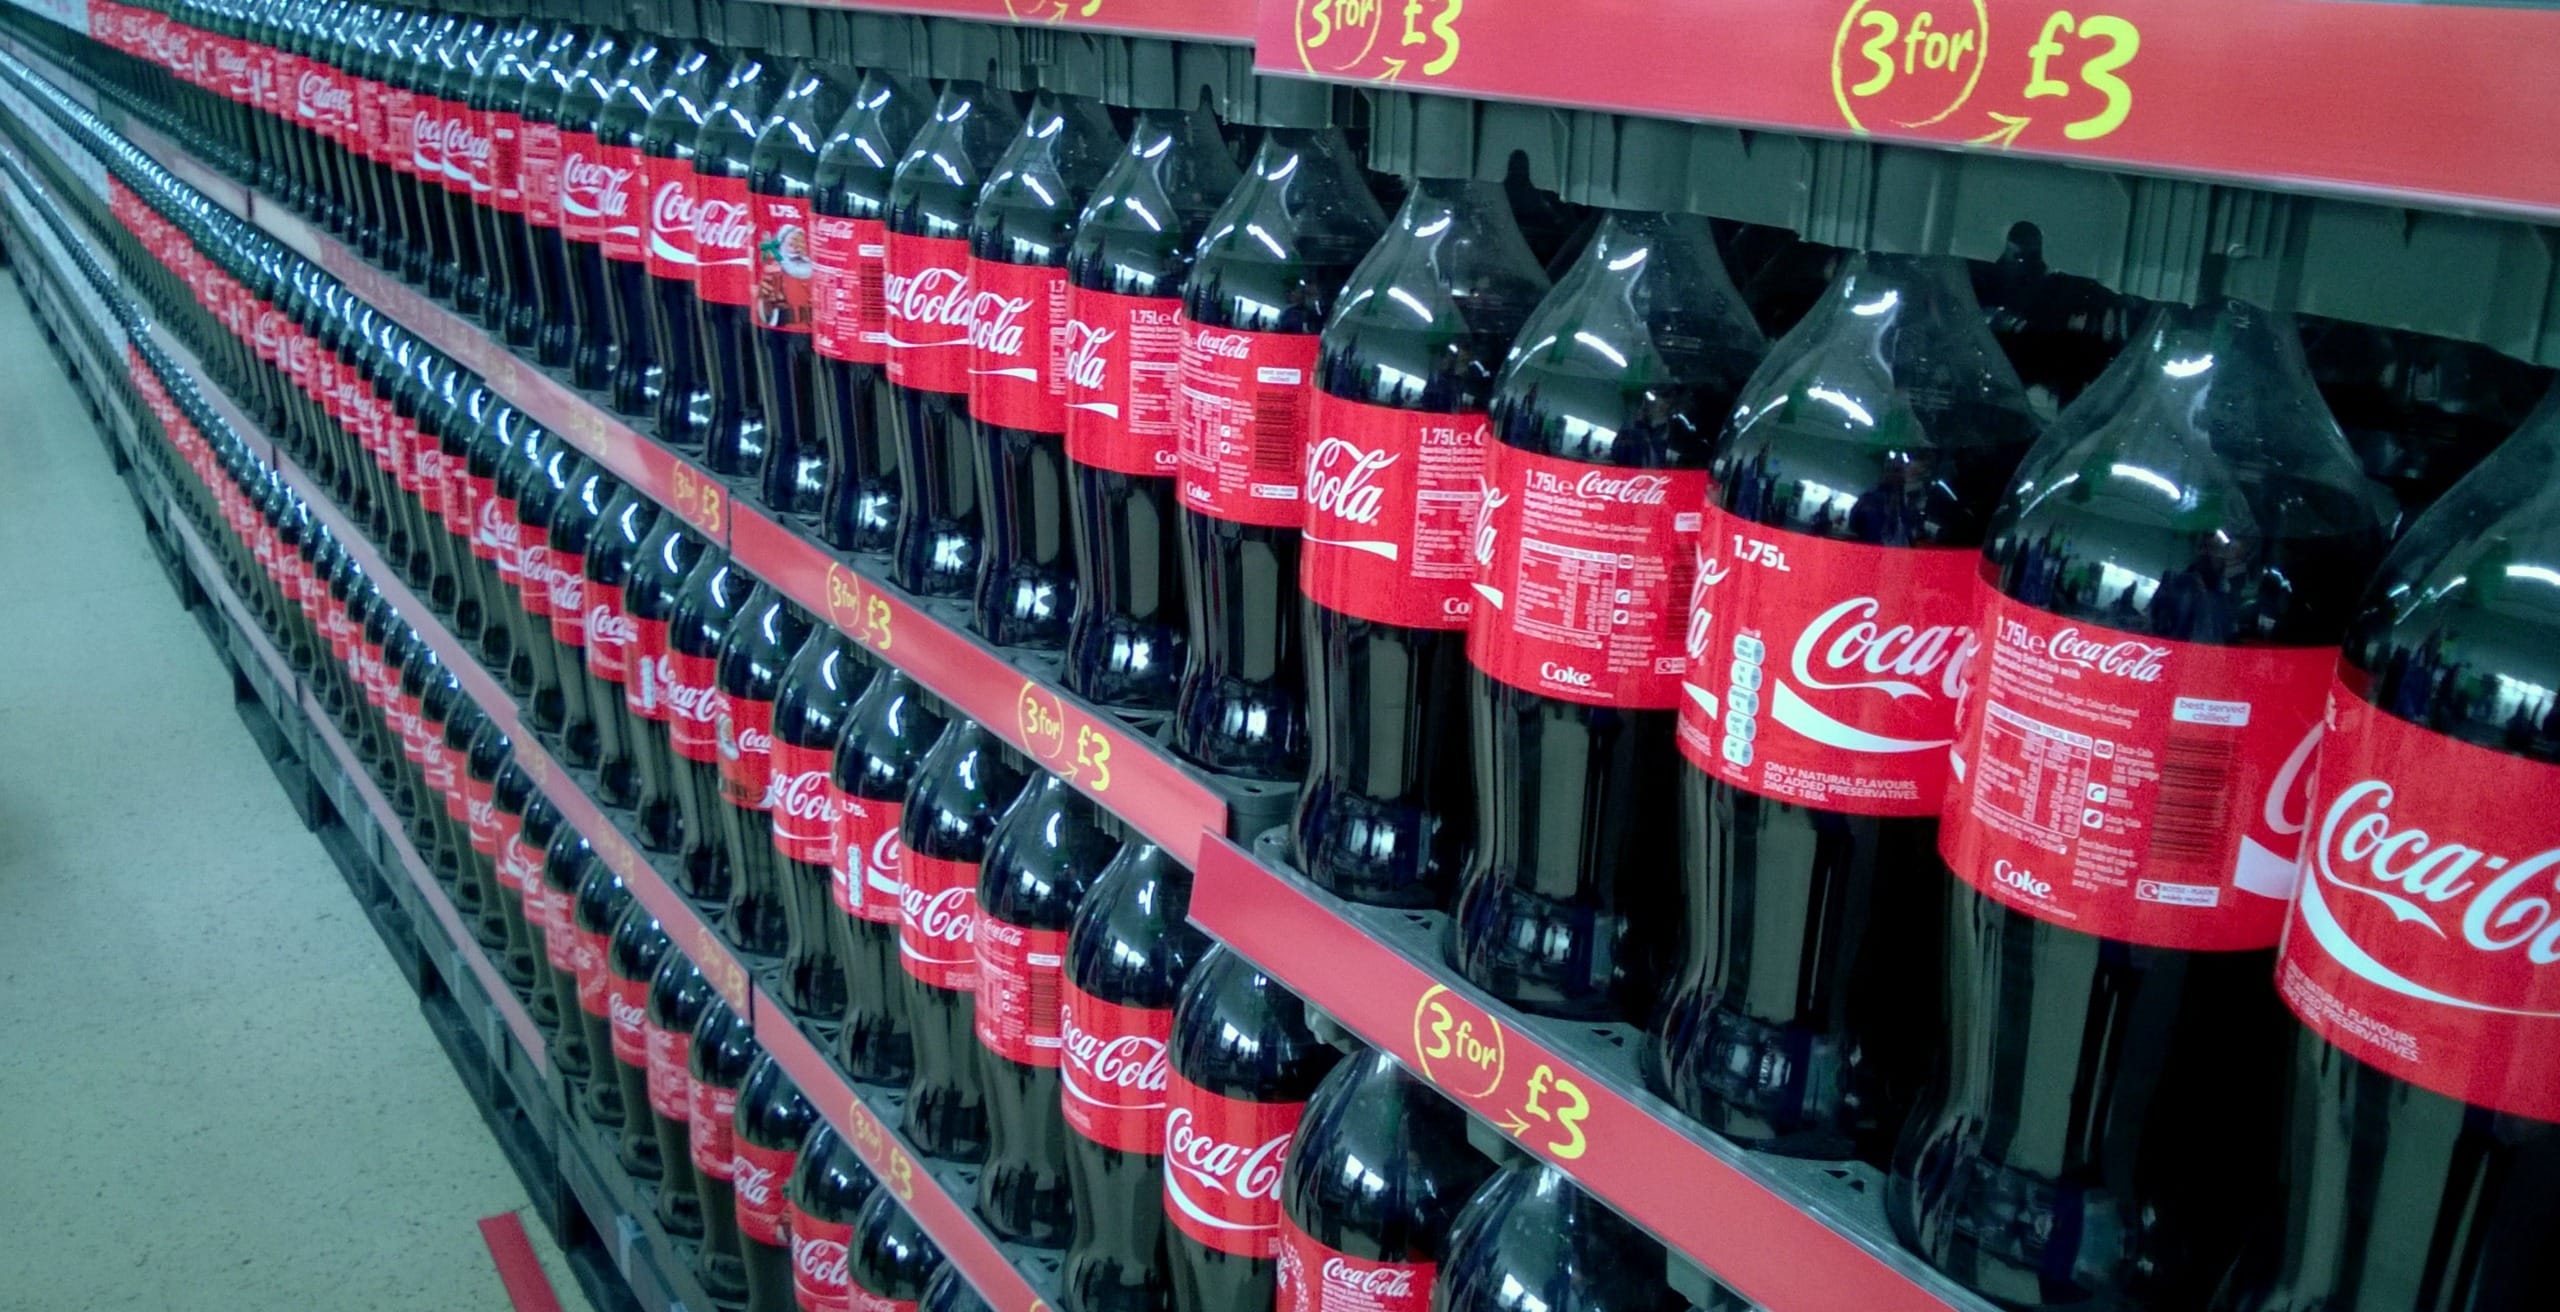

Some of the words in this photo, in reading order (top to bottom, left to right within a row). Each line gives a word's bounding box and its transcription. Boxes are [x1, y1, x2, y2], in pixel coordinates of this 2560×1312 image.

[1402, 0, 1463, 76] £3
[1852, 10, 1899, 96] 3
[1904, 11, 1974, 75] for
[2023, 10, 2140, 140] £3
[1576, 470, 1673, 505] Coca-Cola
[1733, 534, 1791, 572] 1.75L
[832, 575, 841, 608] 3
[868, 594, 892, 650] £3
[1540, 661, 1592, 687] Coke
[2048, 627, 2173, 682] Coca-Cola
[1026, 696, 1039, 734] 3
[1039, 706, 1060, 740] for
[2180, 699, 2206, 711] best
[2207, 703, 2247, 715] served
[1078, 724, 1111, 792] £3
[1765, 761, 1796, 777] ONLY
[1798, 768, 1854, 786] NATURAL
[1763, 781, 1796, 797] SINCE
[1764, 771, 1782, 784] NO
[1783, 774, 1826, 792] ADDED
[1993, 859, 2052, 899] Coke
[1426, 1002, 1450, 1059] 3
[1455, 1019, 1498, 1071] for
[1525, 1064, 1591, 1161] £3
[1165, 1107, 1293, 1201] Coca-C
[1322, 1257, 1417, 1298] Coca-Cola
